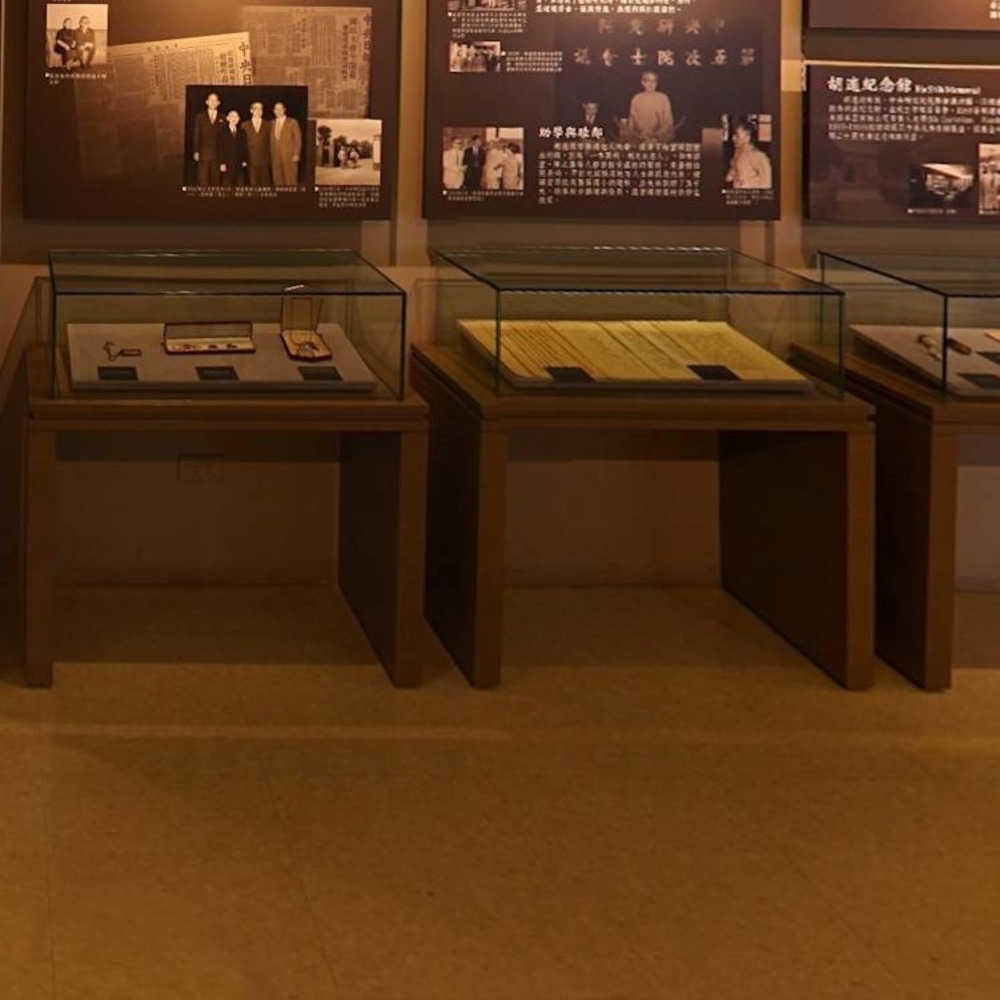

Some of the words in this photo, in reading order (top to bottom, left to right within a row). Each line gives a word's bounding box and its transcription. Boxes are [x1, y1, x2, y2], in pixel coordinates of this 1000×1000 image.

[827, 75, 913, 93] 胡適紀念館
